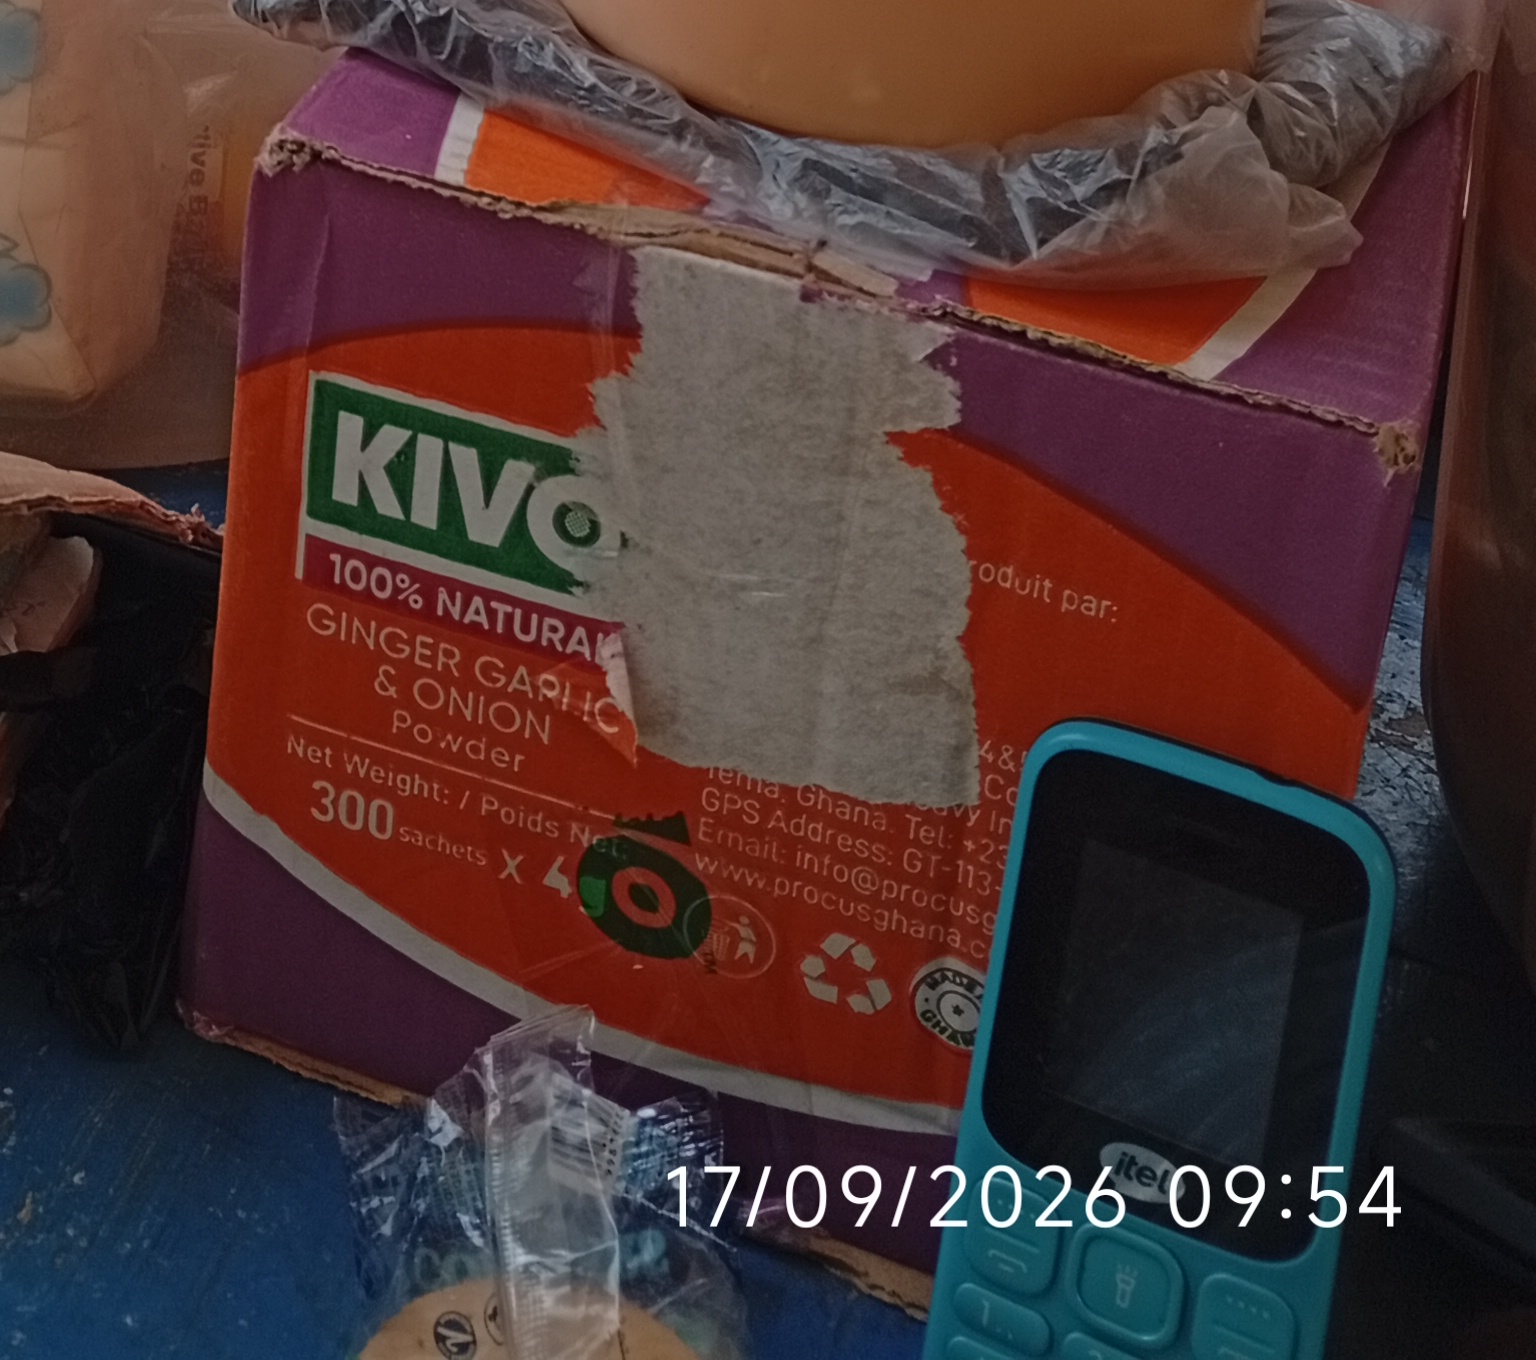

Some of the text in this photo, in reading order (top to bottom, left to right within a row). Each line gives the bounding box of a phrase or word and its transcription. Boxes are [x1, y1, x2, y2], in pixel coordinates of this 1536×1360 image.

[329, 552, 424, 611] 100%
[1060, 588, 1118, 623] par:
[306, 602, 462, 679] GINGER
[373, 664, 551, 746] & ONION
[392, 709, 525, 772] Powder
[286, 733, 333, 769] Net
[343, 751, 450, 806] Weight:
[480, 793, 560, 839] Poids
[796, 783, 894, 832] Ghana.
[903, 812, 954, 851] Tel:
[310, 779, 394, 841] 300
[398, 825, 488, 867] sachets
[697, 816, 787, 864] Email:
[700, 786, 761, 825] GPS
[767, 809, 894, 867] Address:
